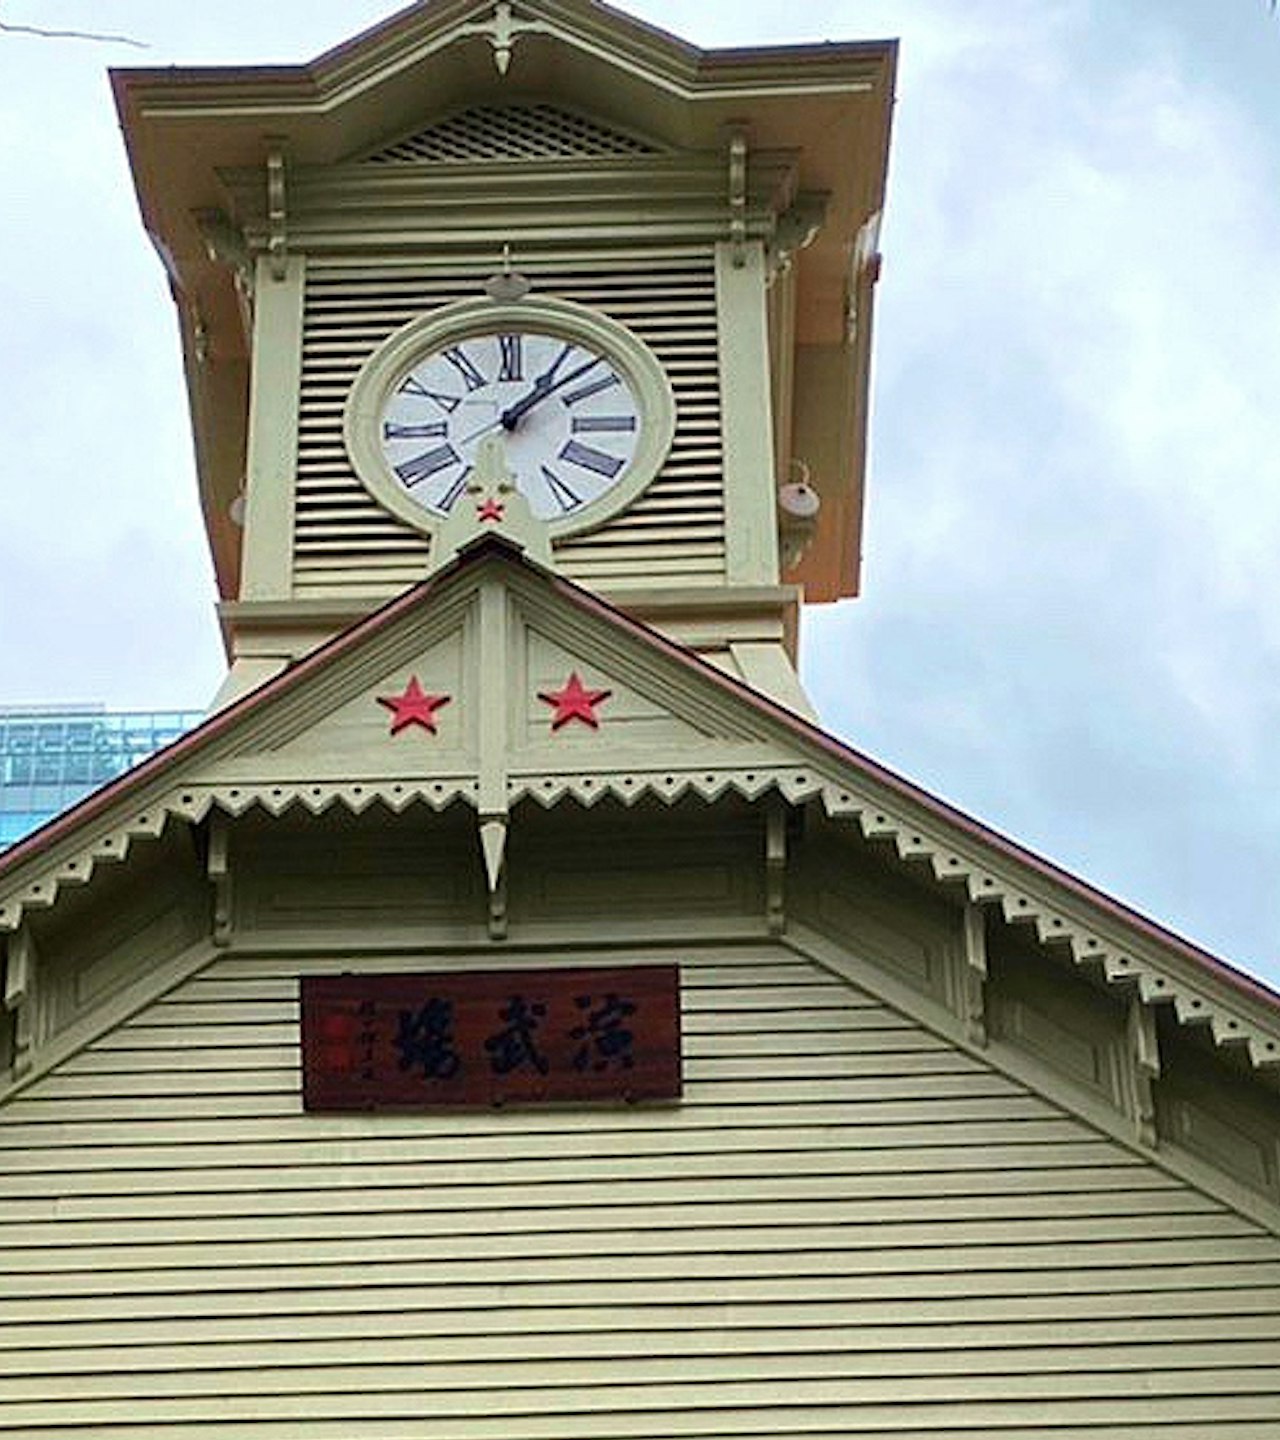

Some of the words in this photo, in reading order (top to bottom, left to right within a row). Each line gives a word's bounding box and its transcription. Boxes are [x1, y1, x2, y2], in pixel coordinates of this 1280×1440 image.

[441, 346, 489, 392] XI
[497, 333, 523, 382] XII
[398, 376, 463, 413] X
[541, 465, 582, 512] V
